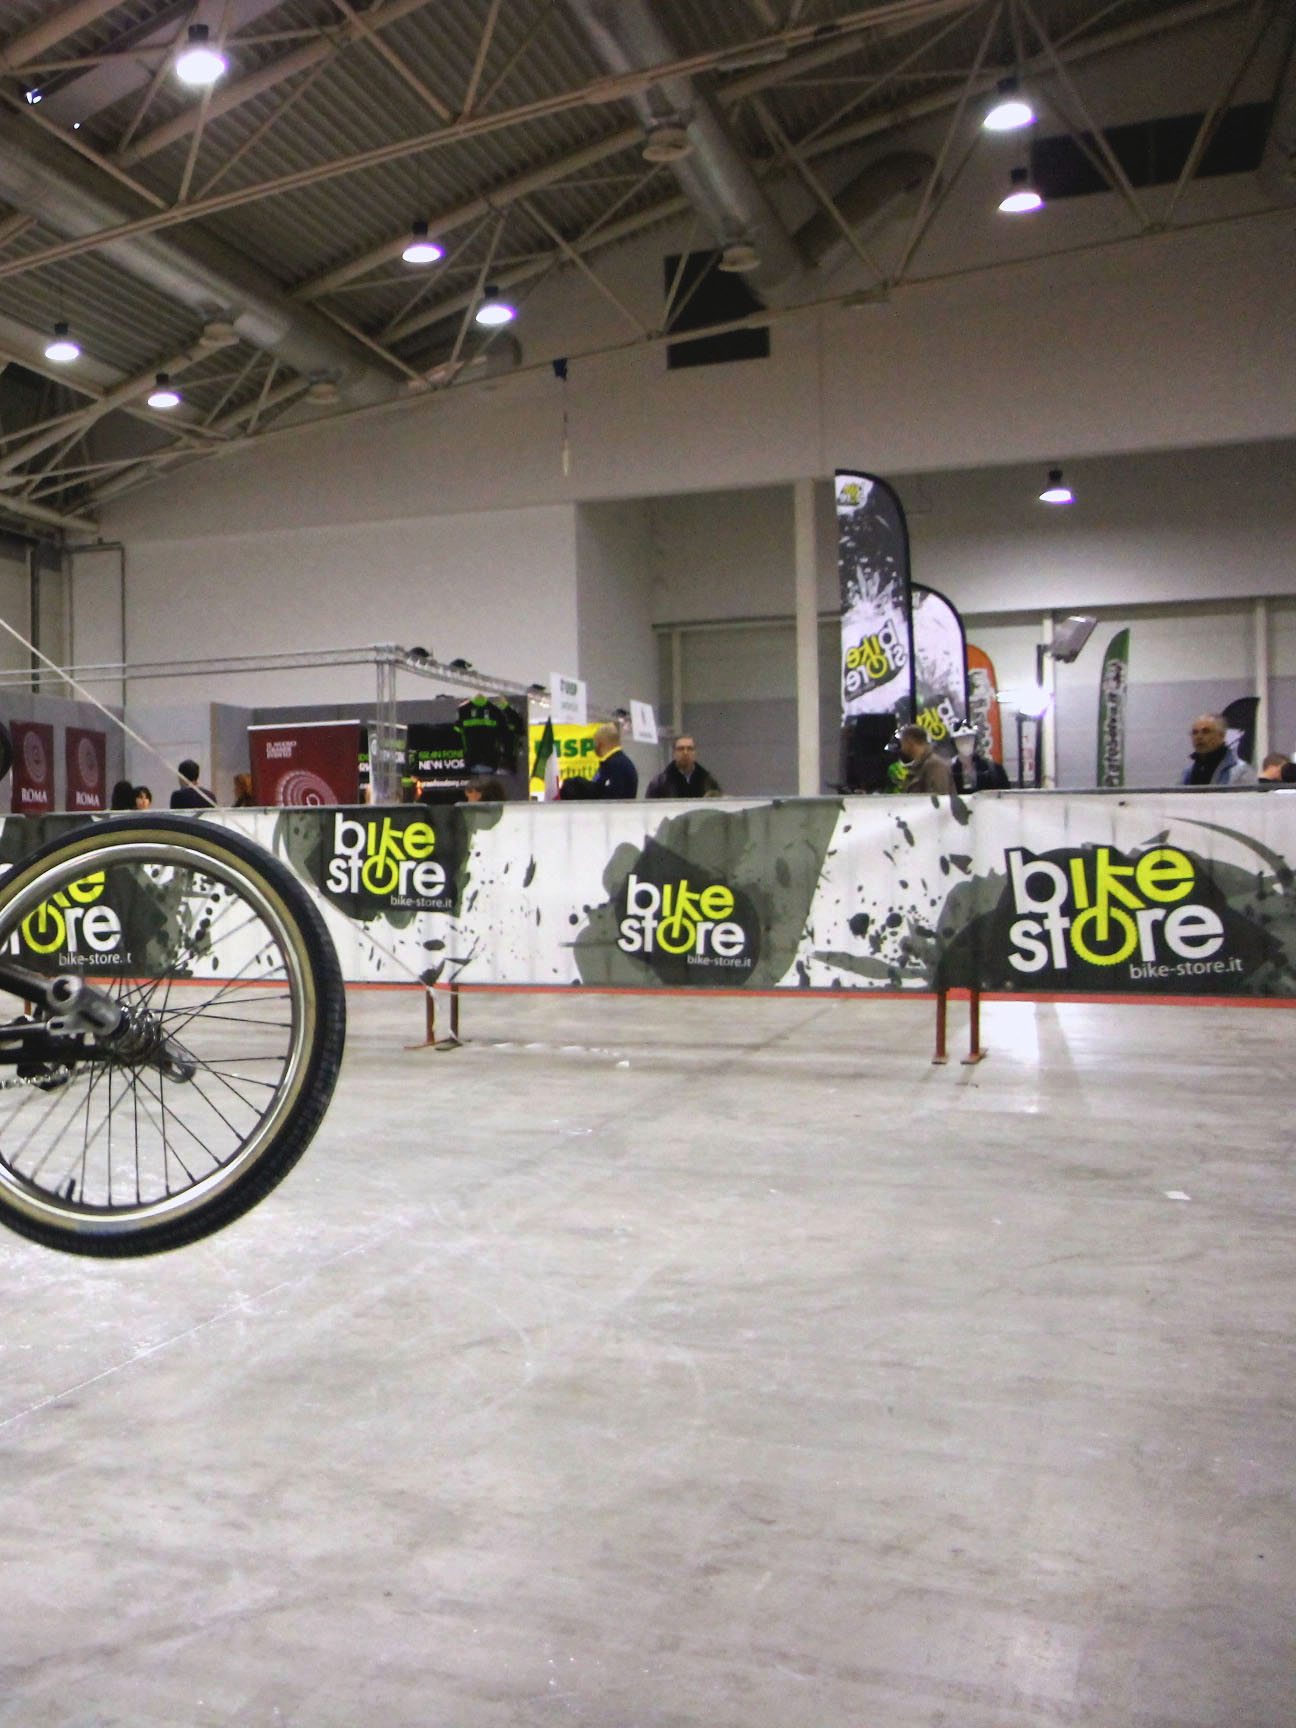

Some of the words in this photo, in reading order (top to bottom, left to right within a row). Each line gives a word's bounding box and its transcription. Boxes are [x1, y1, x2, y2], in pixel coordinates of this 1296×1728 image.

[419, 760, 443, 770] NEW
[21, 787, 48, 803] ROMA
[75, 791, 100, 807] ROMA
[334, 812, 435, 859] bike
[327, 855, 445, 895] store
[1009, 847, 1195, 914] bike
[391, 895, 453, 909] bike-store.it
[626, 874, 735, 920] bike
[617, 911, 745, 955] store
[1008, 904, 1224, 972] store
[59, 952, 131, 966] bike-store.t
[687, 954, 751, 968] bike-store.it
[1129, 958, 1243, 980] bike-store.it
